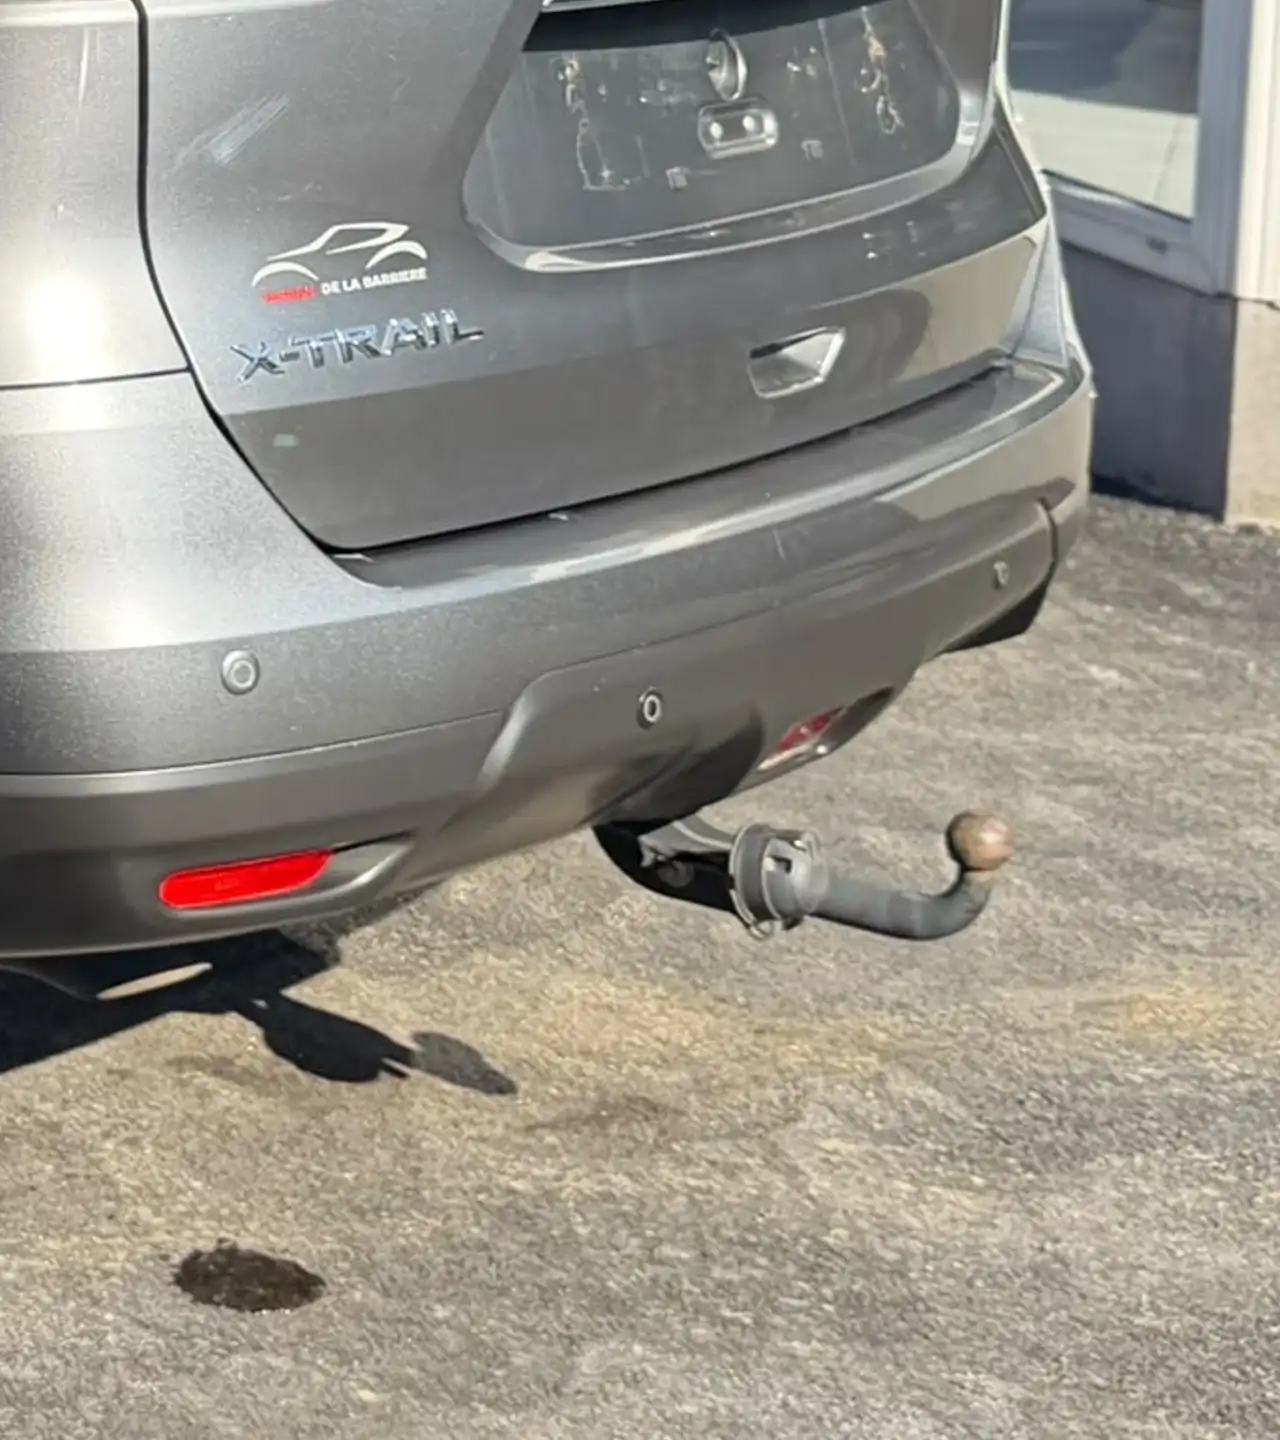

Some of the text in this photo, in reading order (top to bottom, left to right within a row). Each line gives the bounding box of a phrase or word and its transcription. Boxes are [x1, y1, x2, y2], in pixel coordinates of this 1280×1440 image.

[320, 280, 341, 296] DE
[342, 277, 360, 292] LA
[230, 308, 485, 384] X-TRAIL
